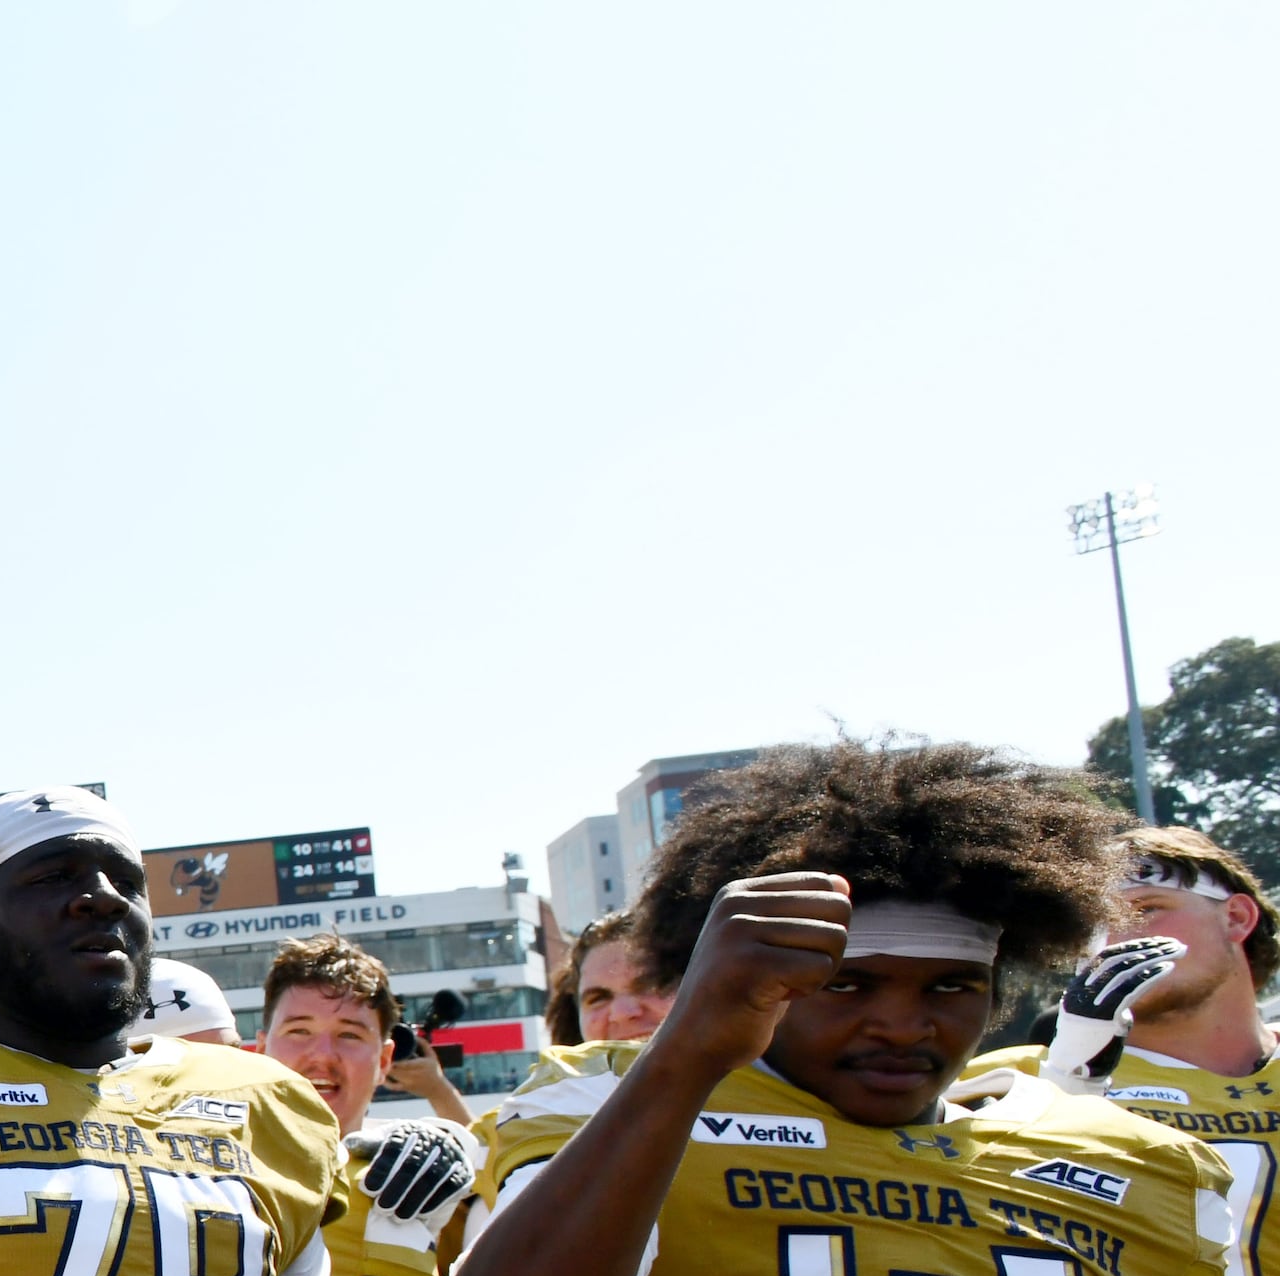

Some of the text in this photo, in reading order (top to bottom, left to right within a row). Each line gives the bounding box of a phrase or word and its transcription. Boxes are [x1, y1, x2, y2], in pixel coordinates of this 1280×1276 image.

[292, 843, 312, 856] 10
[332, 839, 352, 852] 41
[293, 864, 314, 878] 24
[335, 860, 355, 873] 14
[225, 912, 321, 935] HYUNDAI
[335, 905, 407, 923] FIELD
[178, 1098, 246, 1121] ACC
[155, 1130, 254, 1176] TECH
[1037, 1160, 1126, 1203] ACC
[723, 1168, 978, 1228] GEORGIA
